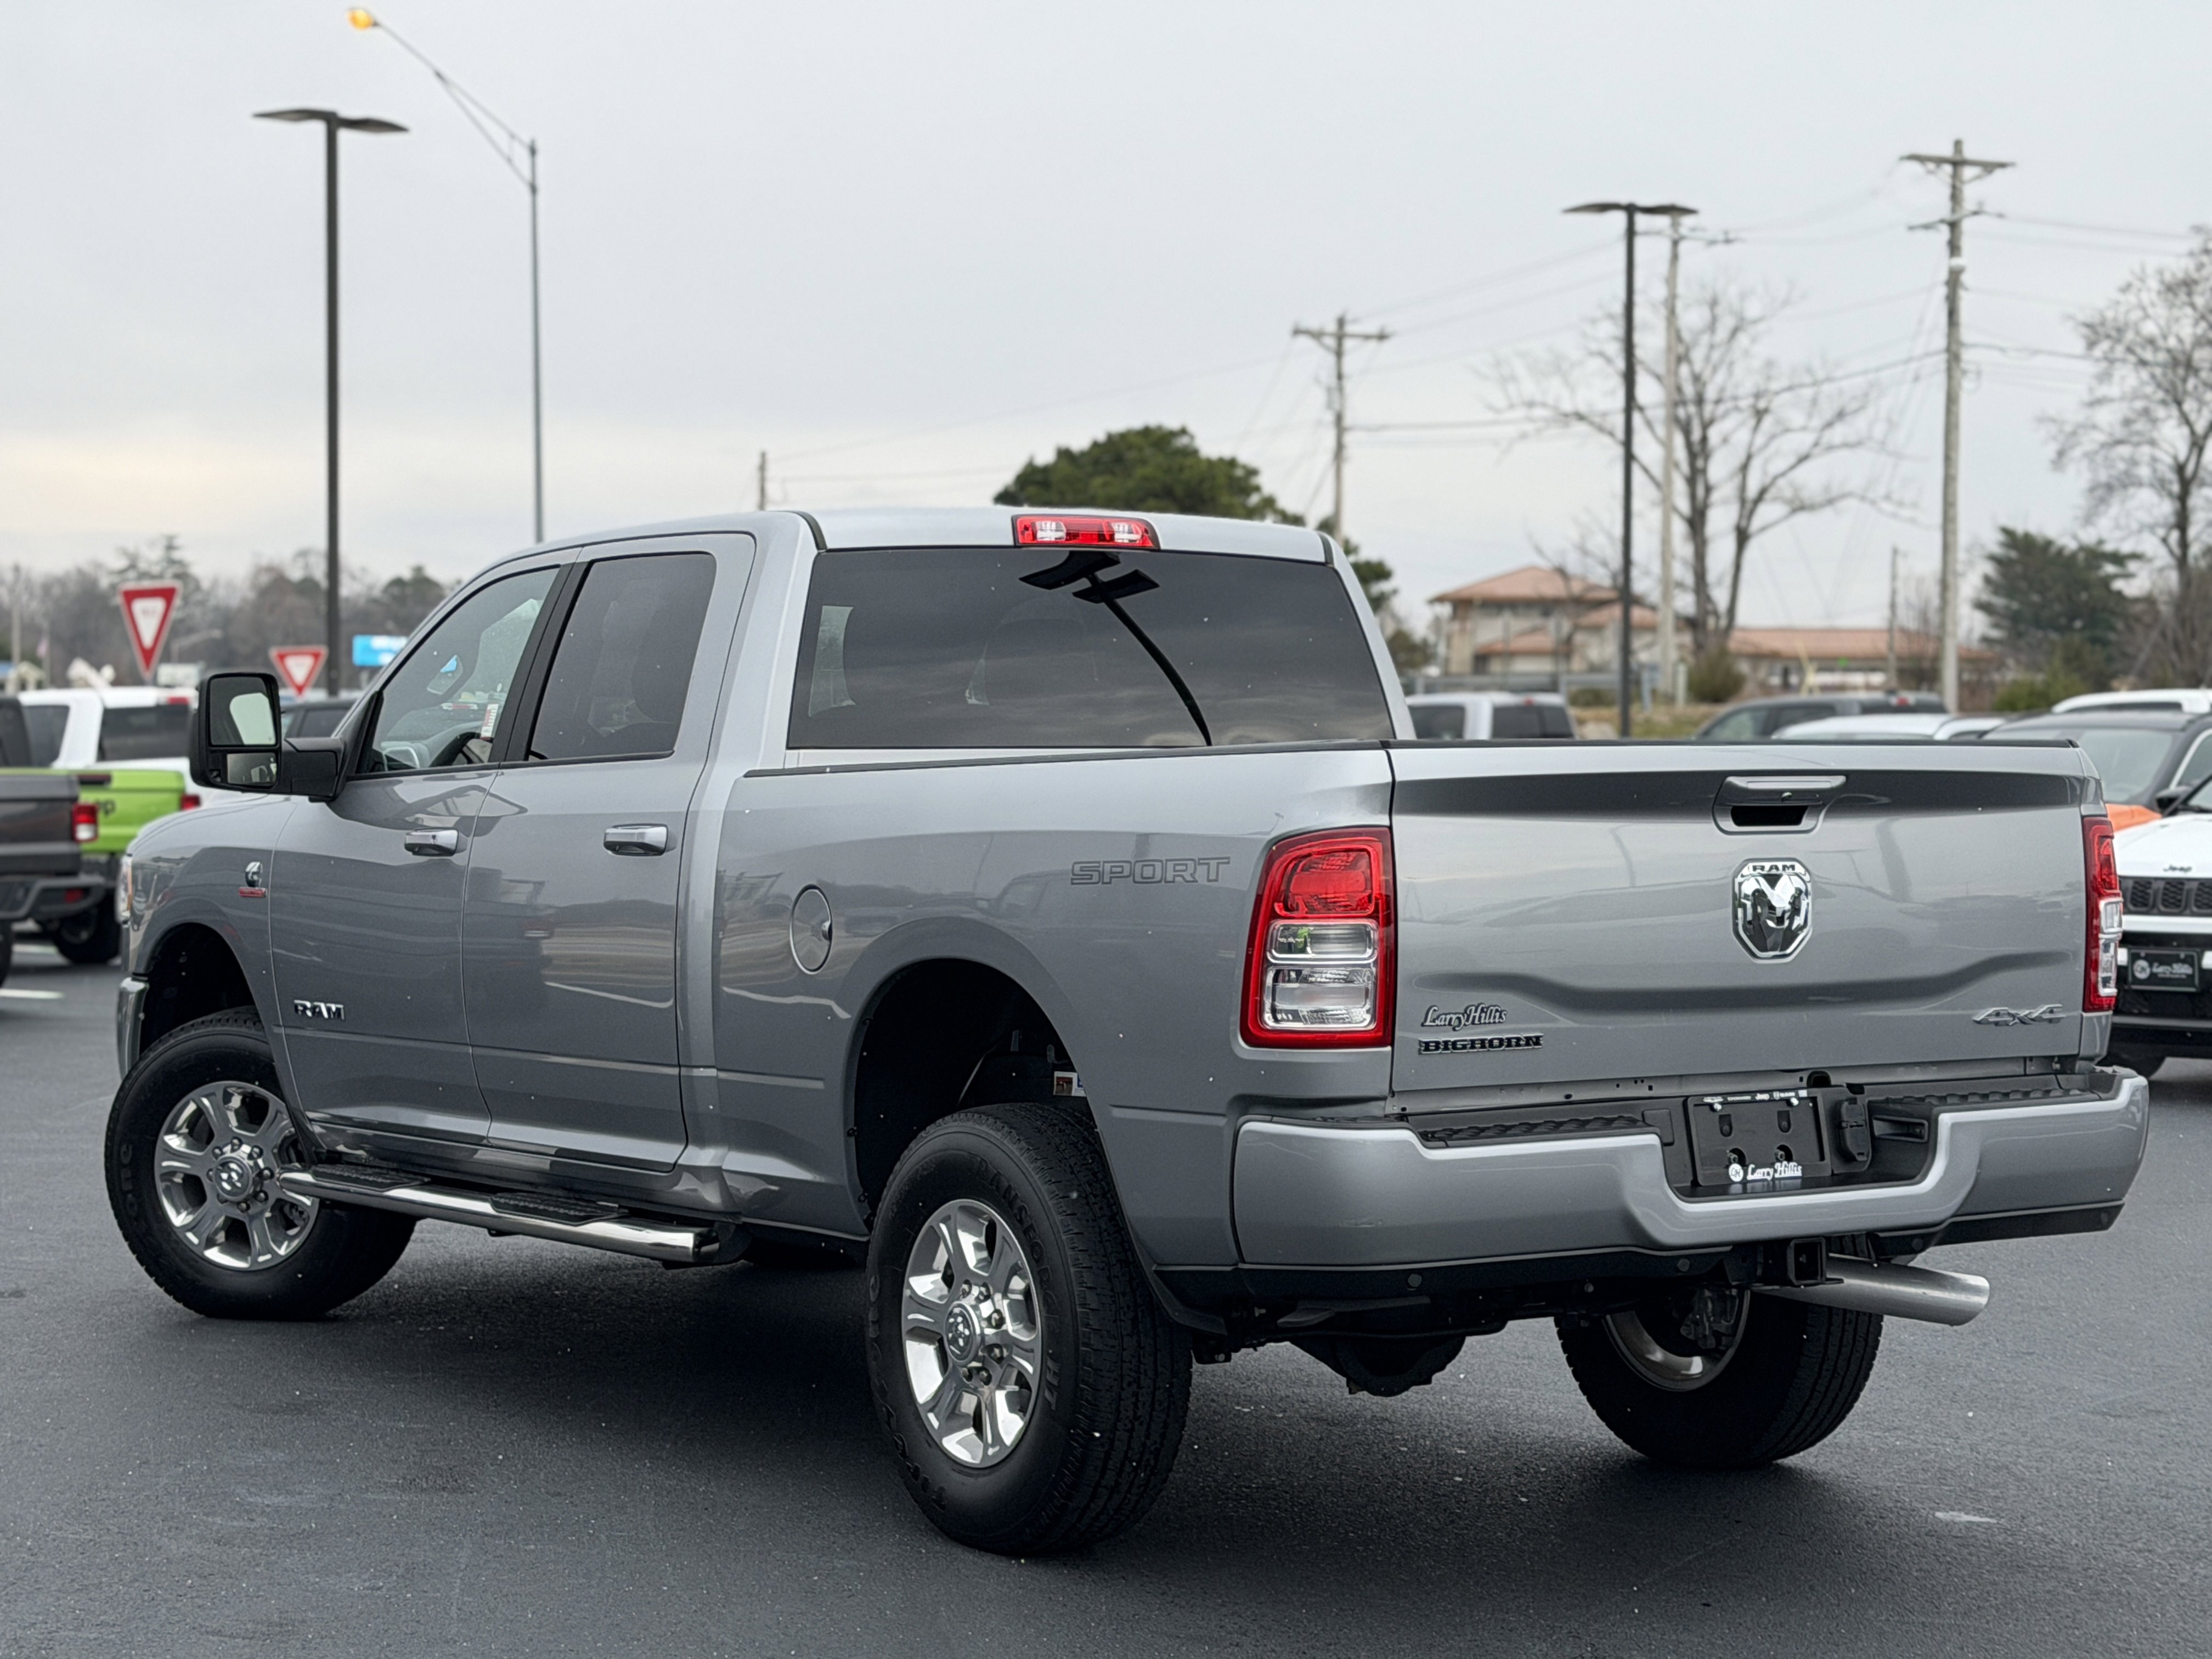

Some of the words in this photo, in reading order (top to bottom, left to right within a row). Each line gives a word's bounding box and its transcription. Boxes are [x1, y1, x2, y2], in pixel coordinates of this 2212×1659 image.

[1070, 856, 1231, 885] SPORT
[294, 1000, 345, 1020] RAM
[1419, 1032, 1544, 1055] BIGHORN
[1747, 1164, 1774, 1181] Larry
[1774, 1161, 1803, 1178] Hillis
